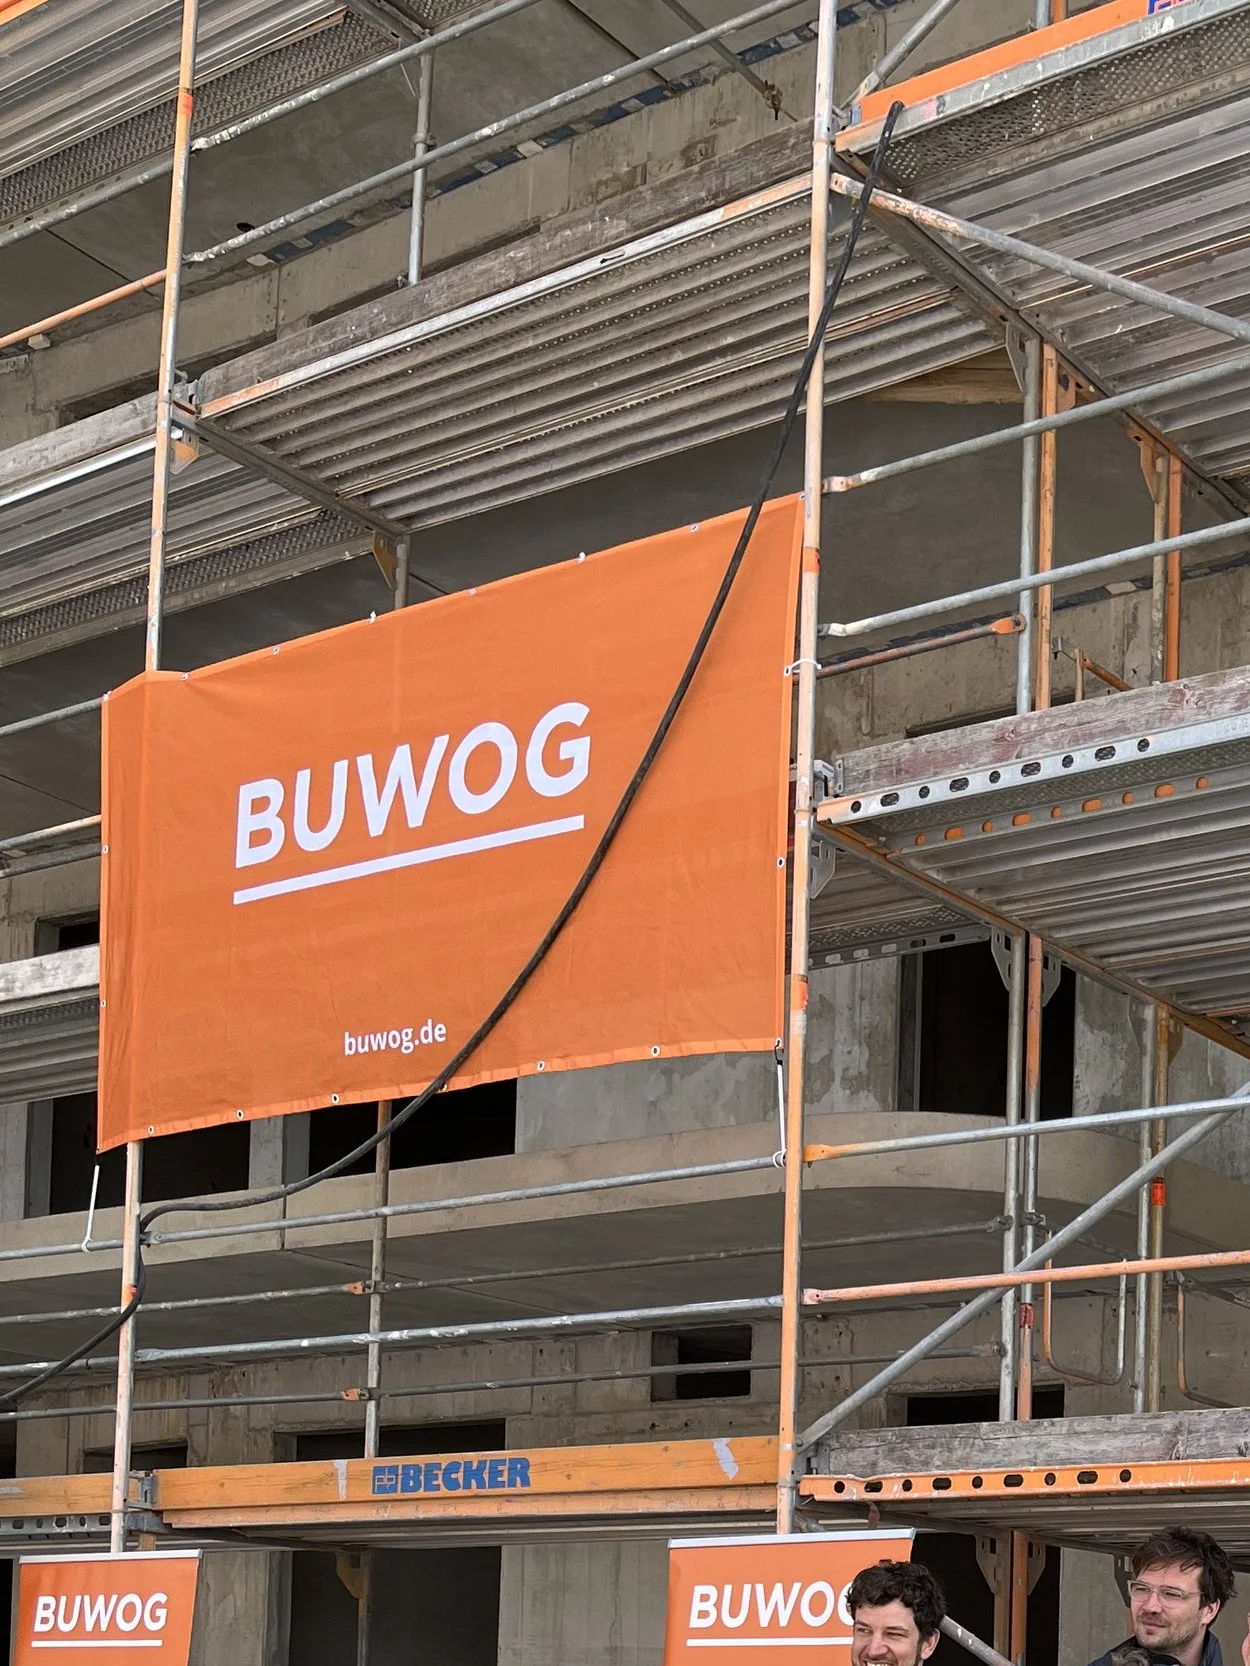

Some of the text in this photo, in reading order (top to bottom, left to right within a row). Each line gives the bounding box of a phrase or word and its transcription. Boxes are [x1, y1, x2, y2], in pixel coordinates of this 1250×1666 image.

[235, 702, 592, 869] BUWOG
[343, 1018, 447, 1056] buwog.de
[400, 1457, 531, 1494] BECKER
[33, 1593, 168, 1632] BUWOG
